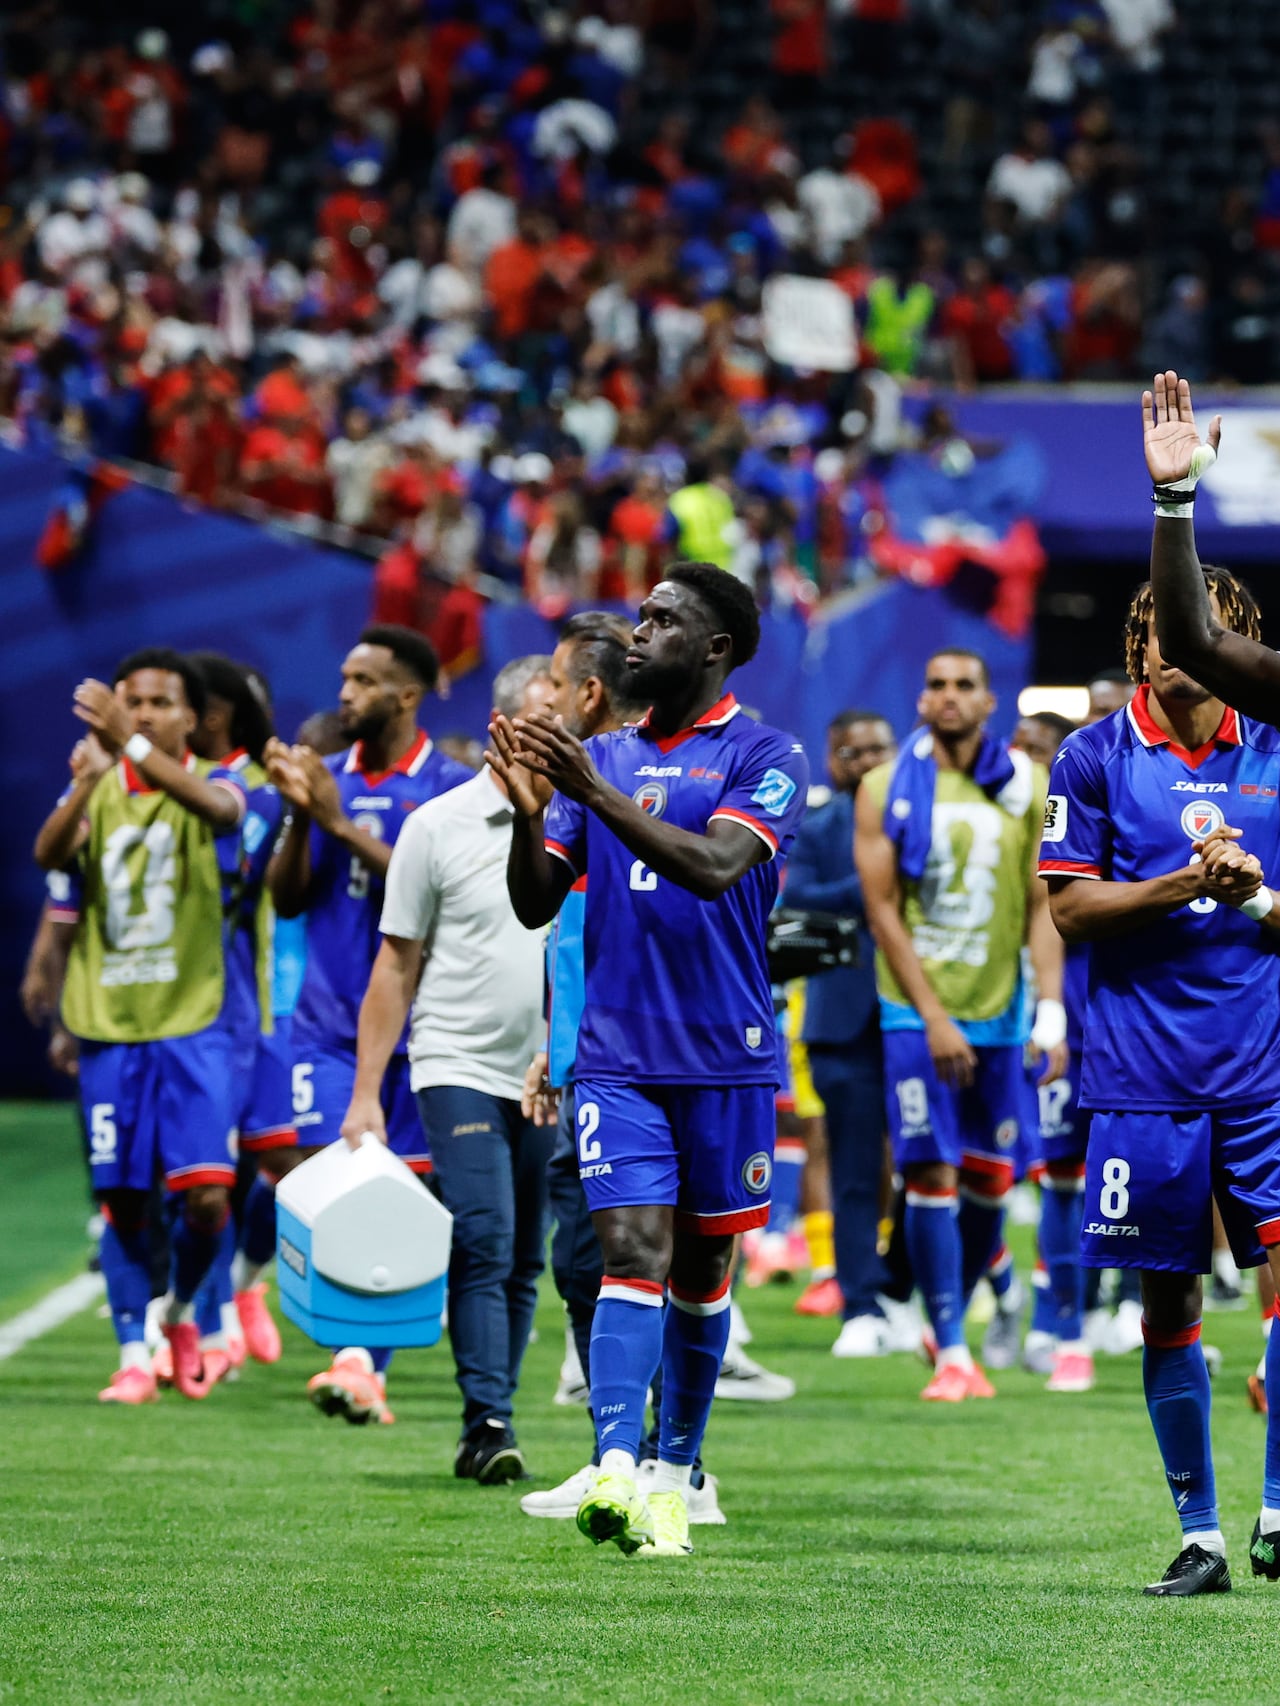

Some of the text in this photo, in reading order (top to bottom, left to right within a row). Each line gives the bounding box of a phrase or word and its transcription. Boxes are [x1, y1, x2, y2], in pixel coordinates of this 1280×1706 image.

[634, 766, 682, 777] SAETA
[1170, 781, 1229, 793] SAETA
[292, 1062, 314, 1114] 5
[896, 1077, 928, 1126] 19
[1036, 1078, 1072, 1127] 17
[91, 1103, 117, 1153] 5
[578, 1102, 602, 1162] 2
[1100, 1158, 1130, 1219] 8
[1084, 1222, 1140, 1236] SAETA
[601, 1403, 626, 1416] FHF
